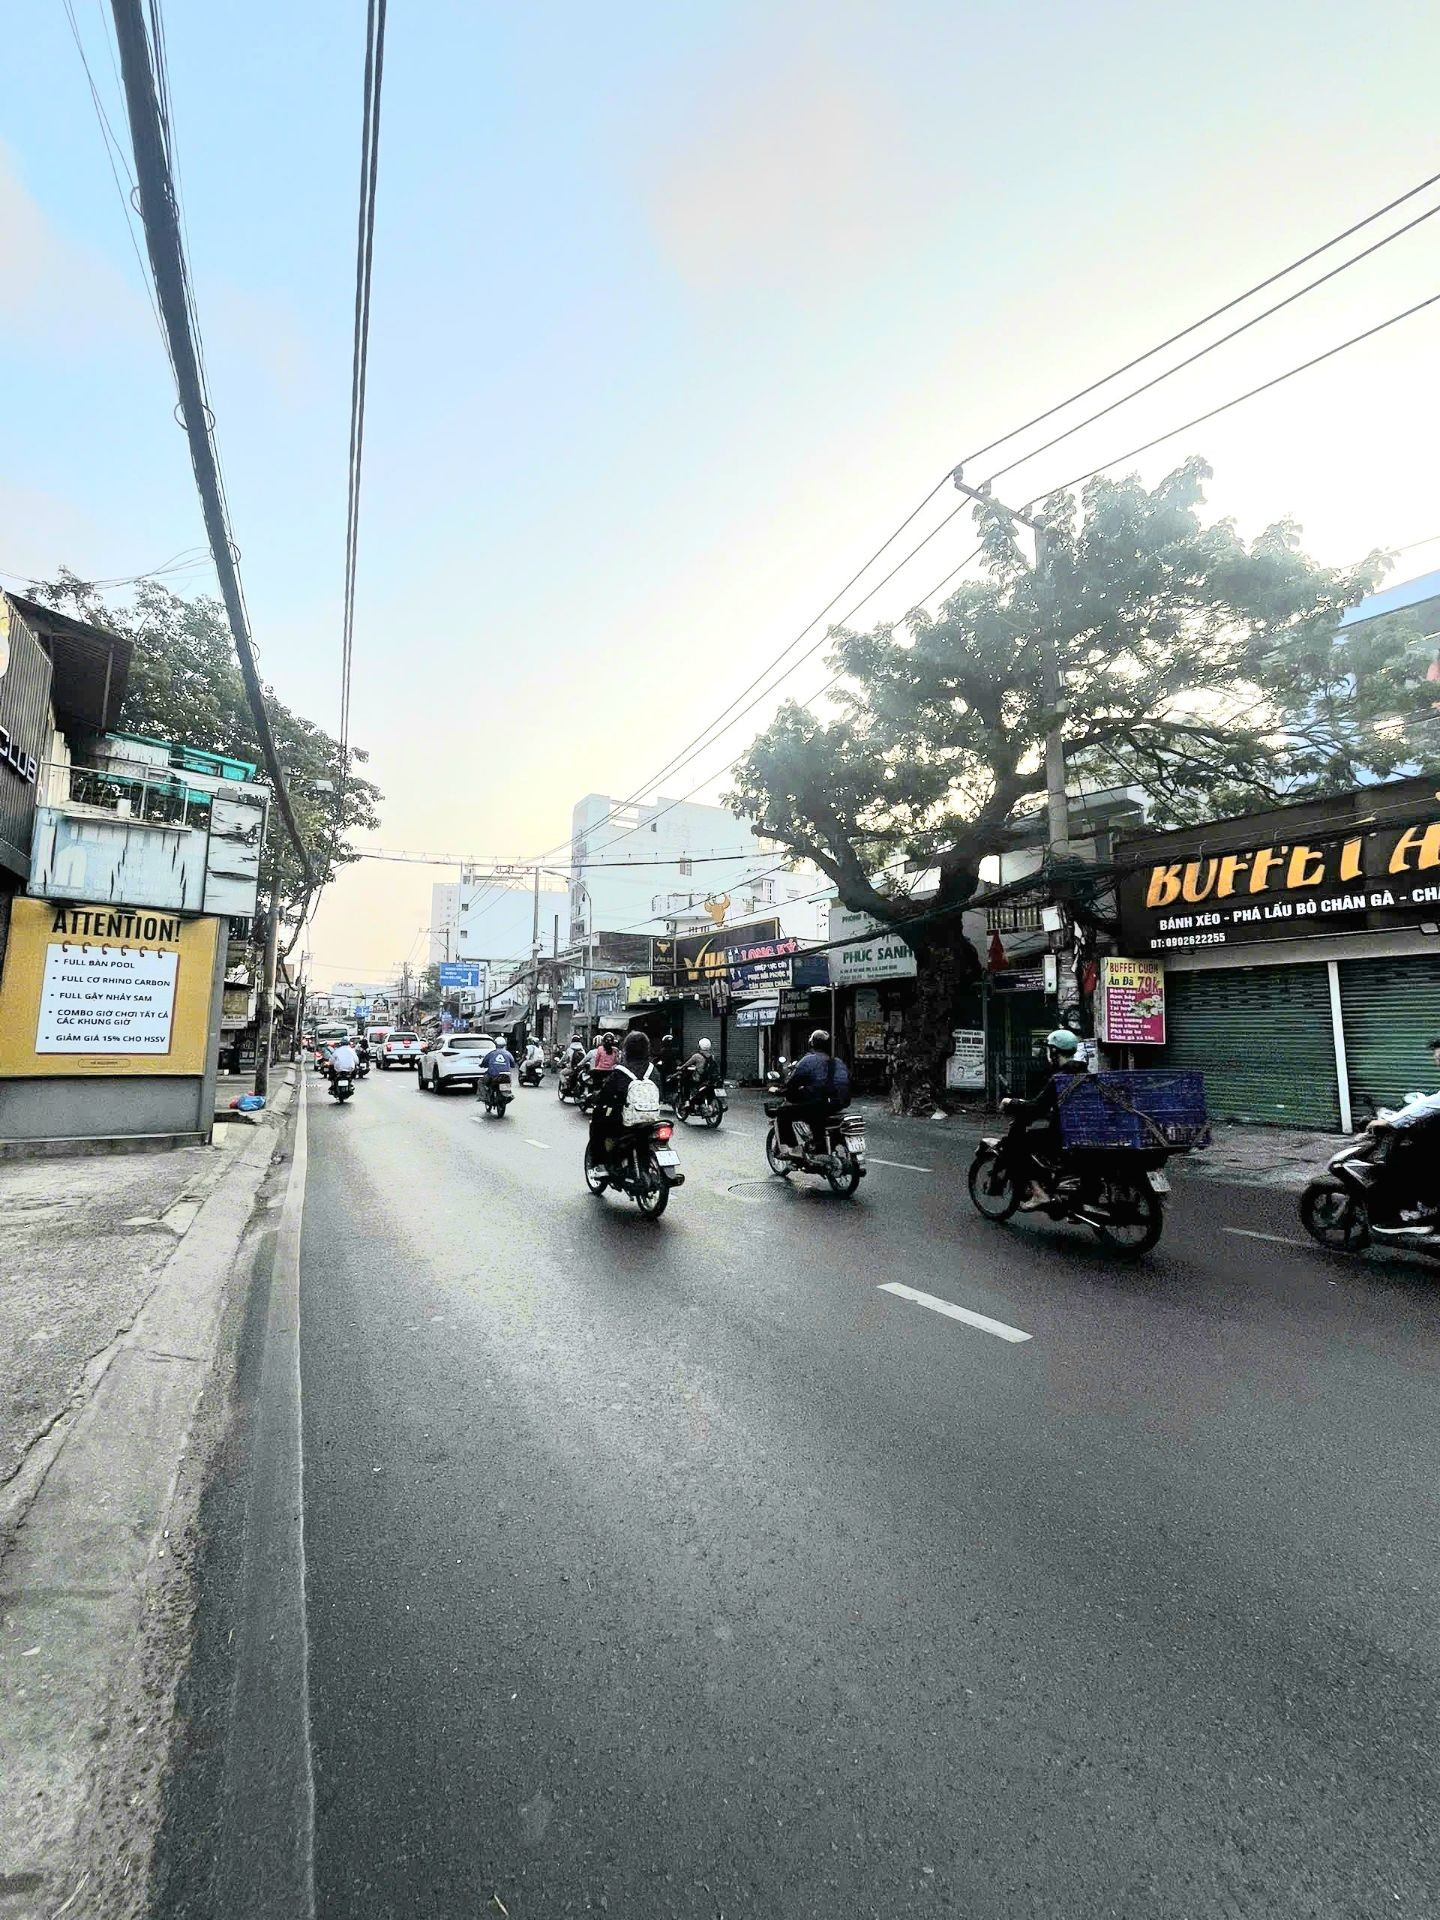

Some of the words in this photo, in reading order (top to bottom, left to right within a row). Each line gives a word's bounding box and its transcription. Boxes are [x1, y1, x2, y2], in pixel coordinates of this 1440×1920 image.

[1160, 916, 1193, 931] BÁNH
[1195, 912, 1221, 927] XÈO
[1233, 906, 1261, 922] PHÁ
[1296, 898, 1317, 915] BÒ
[1321, 894, 1366, 912] CHÂN
[1370, 889, 1395, 907] GÀ
[51, 909, 181, 943] ATTENTION!
[842, 948, 873, 964] PHÚC
[110, 961, 136, 969] POOL
[1110, 962, 1136, 973] BUFFET
[61, 975, 85, 983] FULL
[102, 977, 132, 986] RHINO
[134, 979, 171, 988] CARBON
[59, 992, 83, 1000] FULL
[57, 1009, 94, 1017] COMBO
[144, 1036, 166, 1044] HSSV
